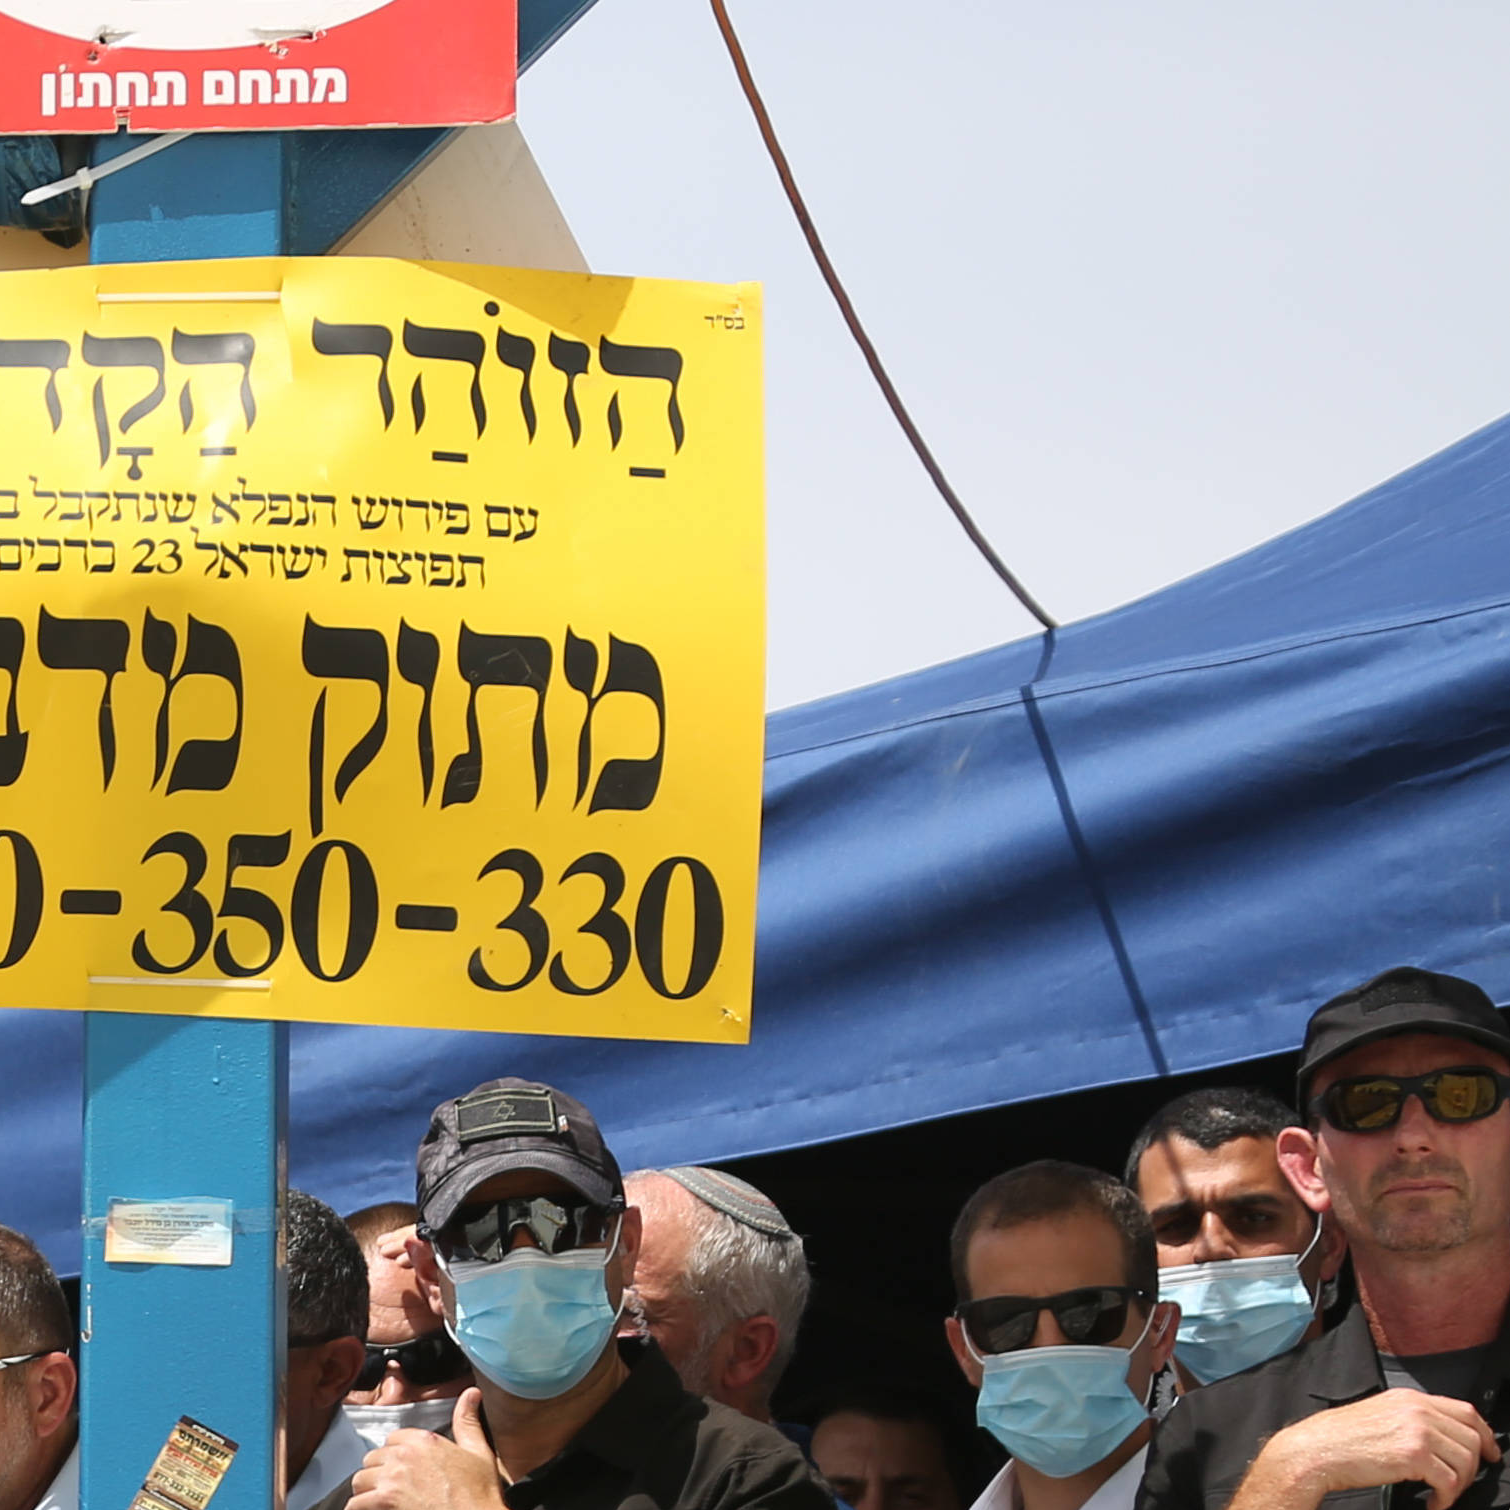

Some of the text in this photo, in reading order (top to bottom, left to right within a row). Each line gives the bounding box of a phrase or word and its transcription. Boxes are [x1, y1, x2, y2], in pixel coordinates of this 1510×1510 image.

[41, 67, 348, 116] מתחם תחתון
[29, 475, 197, 533] שנתקבל
[211, 477, 337, 529] הנפלא
[352, 495, 471, 538] פירוש
[484, 503, 539, 542] עם
[131, 538, 183, 574] 23
[190, 527, 328, 580] ישראל
[340, 547, 486, 589] תפוצות
[302, 613, 666, 839] מתוק
